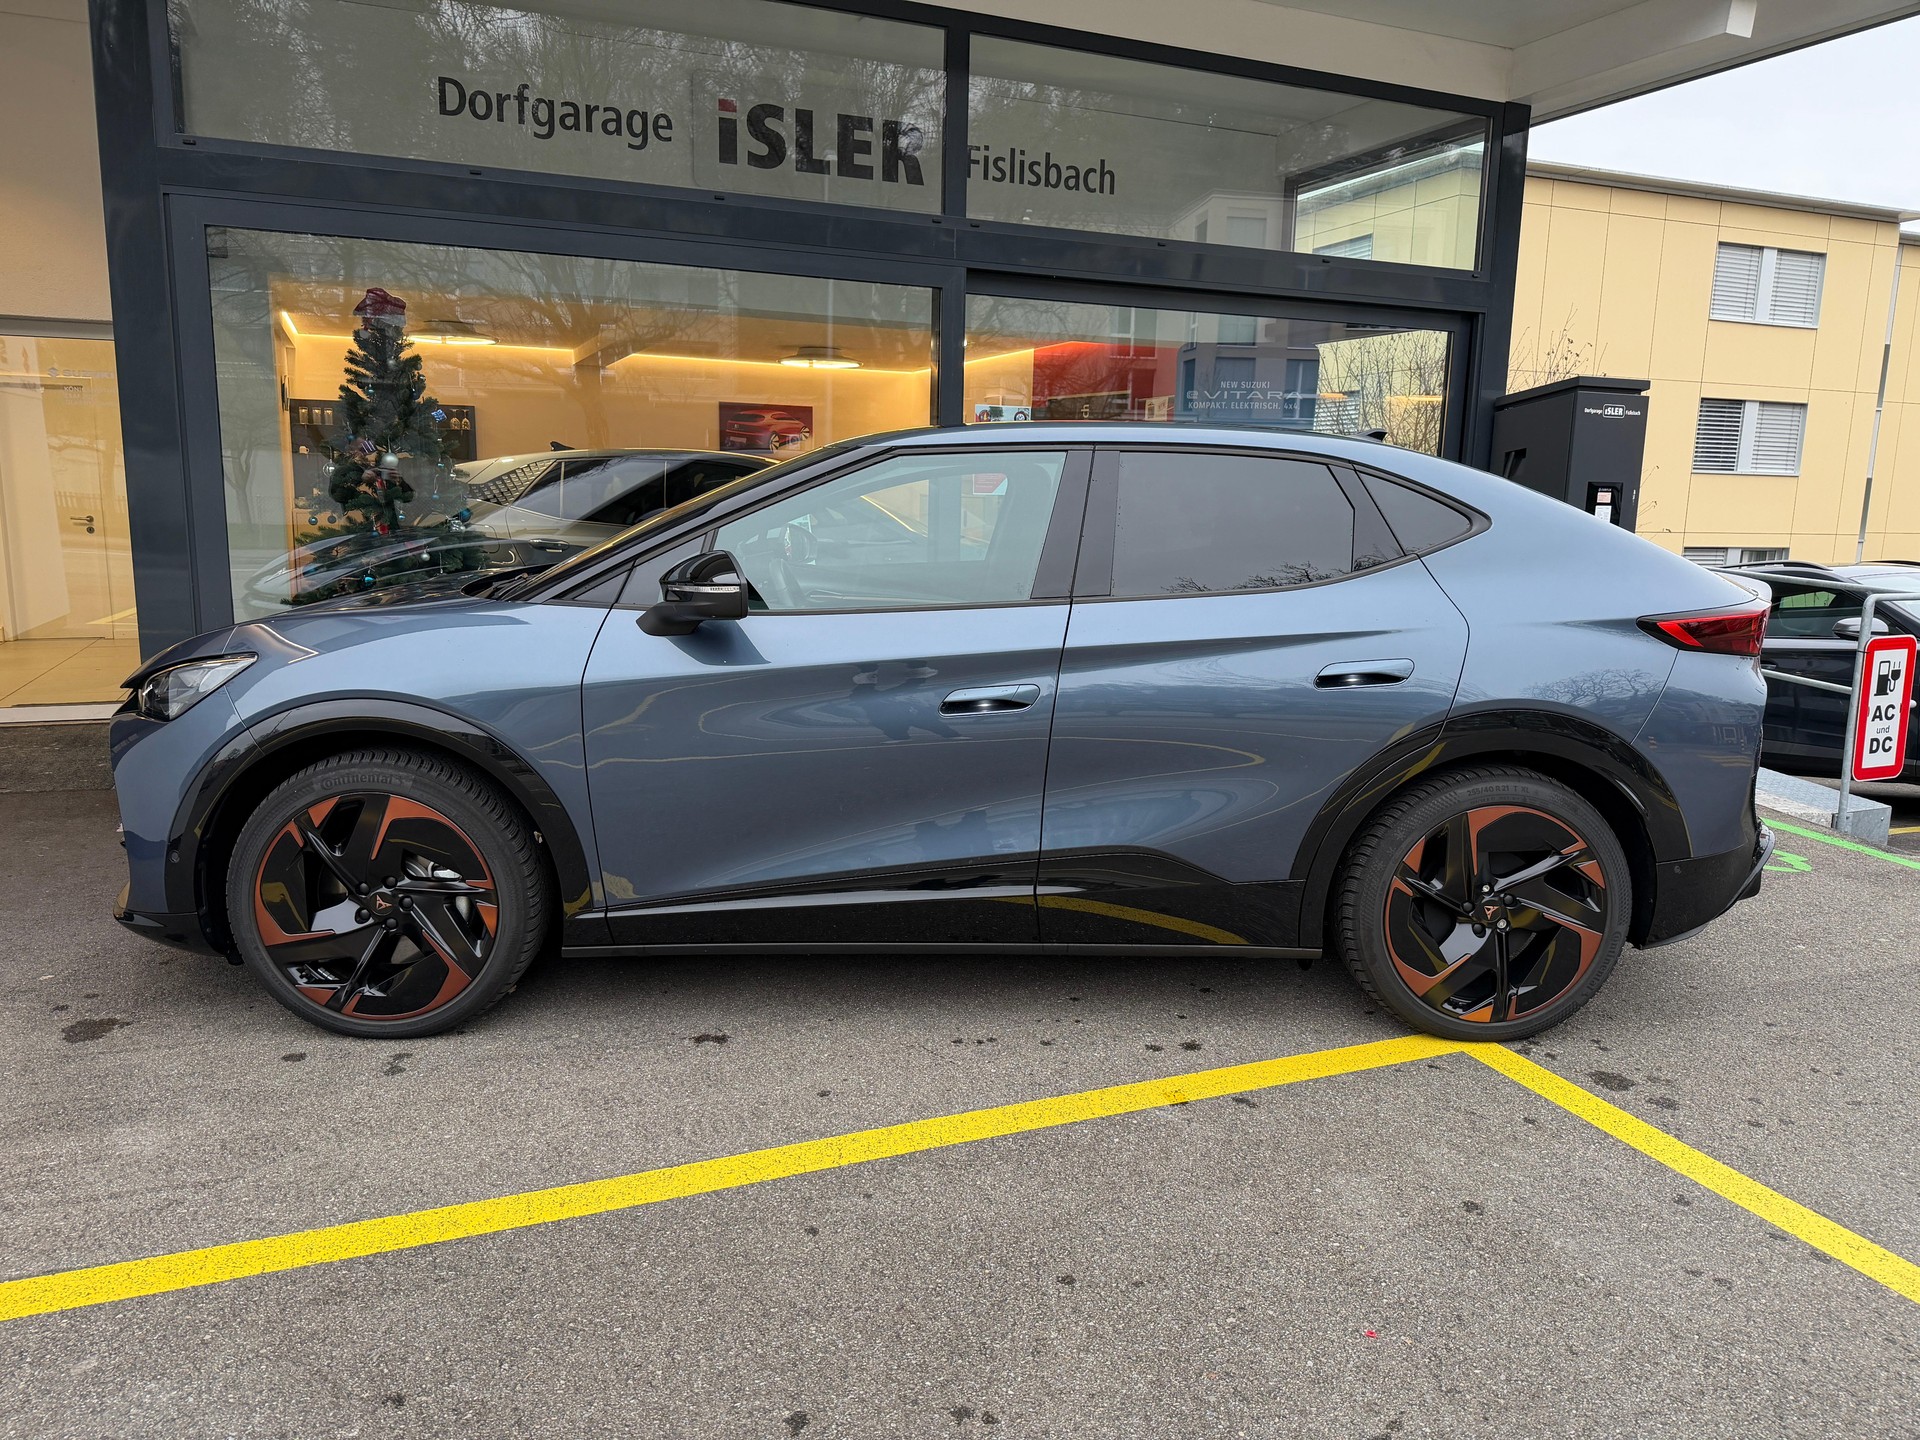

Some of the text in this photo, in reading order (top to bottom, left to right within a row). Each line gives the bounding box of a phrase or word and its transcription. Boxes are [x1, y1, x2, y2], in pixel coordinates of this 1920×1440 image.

[438, 76, 1115, 195] Dorfgarage iSLER Fislisbach
[1220, 381, 1270, 389] NEW SUZUKI
[1203, 390, 1303, 400] VITARA
[1188, 401, 1228, 409] KOMPAKT.
[1230, 401, 1281, 410] ELEKTRISCH.
[1871, 704, 1896, 722] AC
[1876, 725, 1890, 734] und
[1869, 736, 1893, 754] DC
